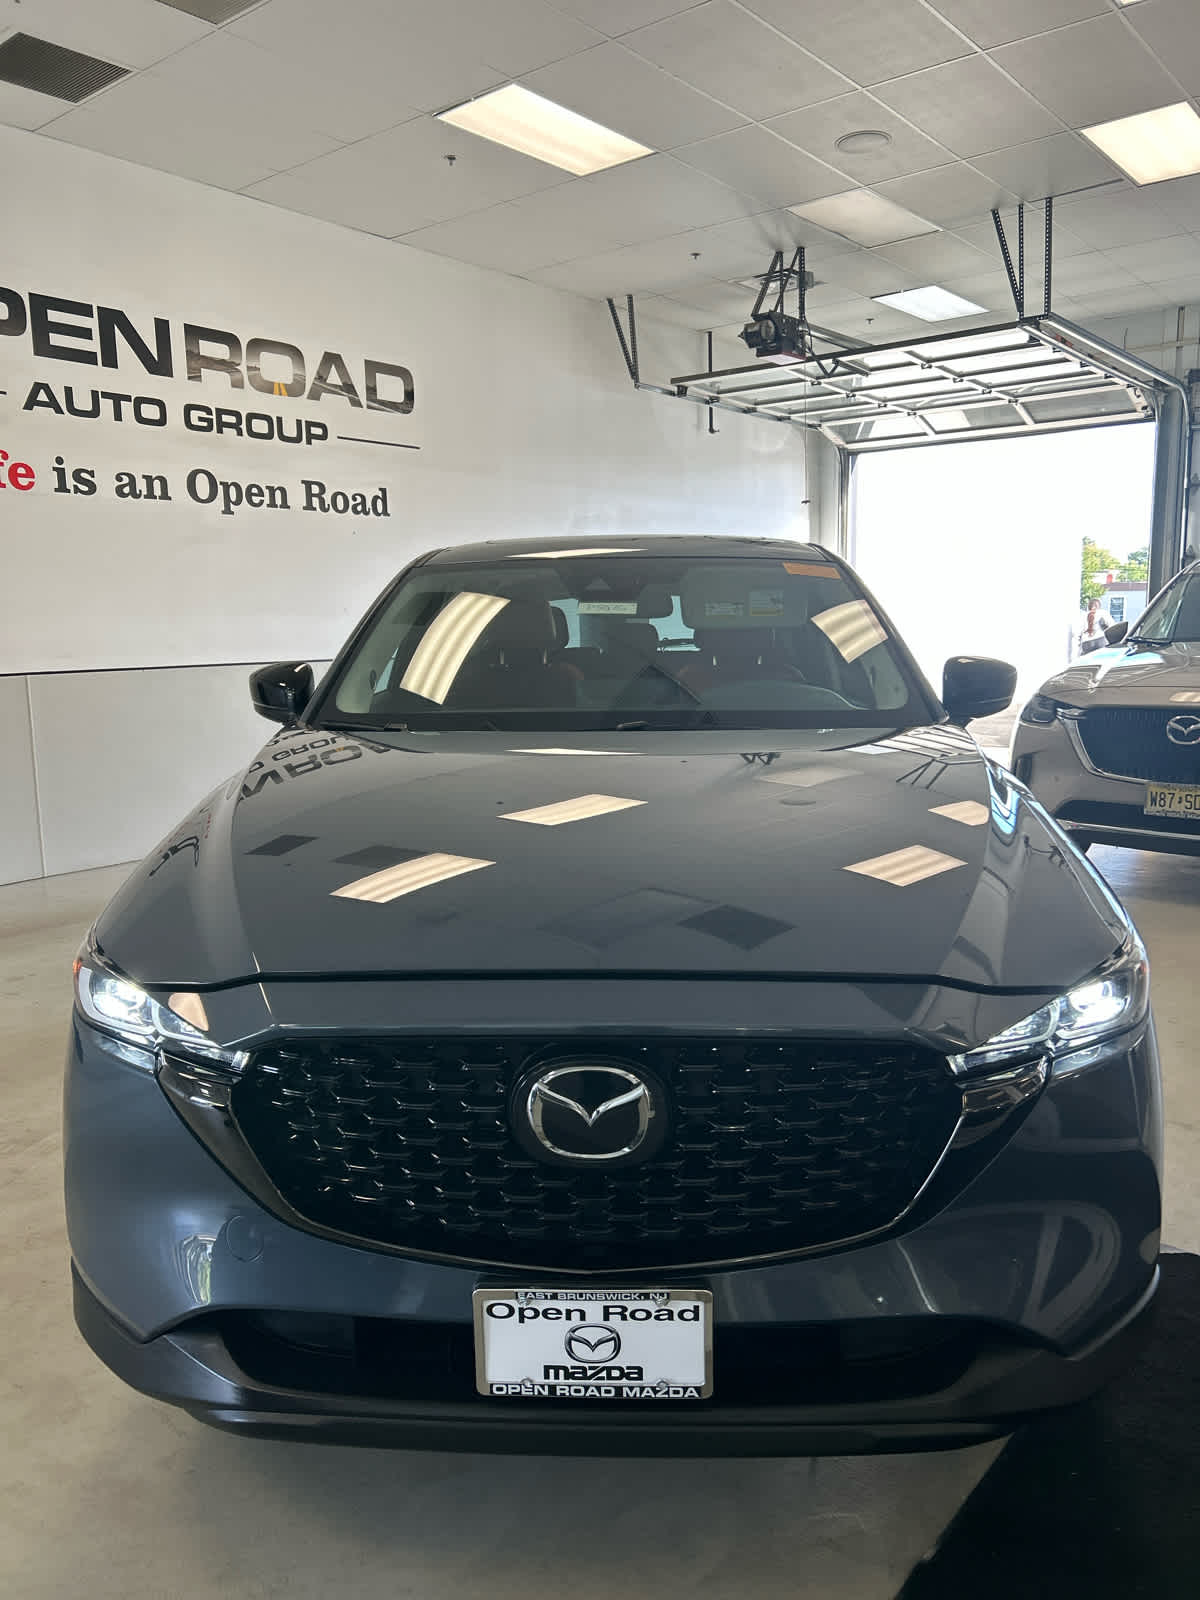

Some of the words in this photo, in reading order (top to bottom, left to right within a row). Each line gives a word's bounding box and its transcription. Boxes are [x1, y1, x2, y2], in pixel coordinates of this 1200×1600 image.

[184, 322, 415, 415] ROAD
[22, 381, 168, 427] AUTO
[183, 403, 329, 446] GROUP
[52, 456, 97, 496] is
[114, 471, 172, 501] an
[186, 468, 291, 516] Open
[301, 479, 391, 517] Road
[486, 1302, 586, 1324] Open
[603, 1304, 700, 1322] Road
[517, 1291, 553, 1300] EAST
[557, 1292, 645, 1300] BRUNSWICK,
[650, 1292, 668, 1301] NJ
[492, 1384, 549, 1396] OPEN
[556, 1386, 615, 1398] ROAD
[623, 1387, 699, 1399] MAZDA
